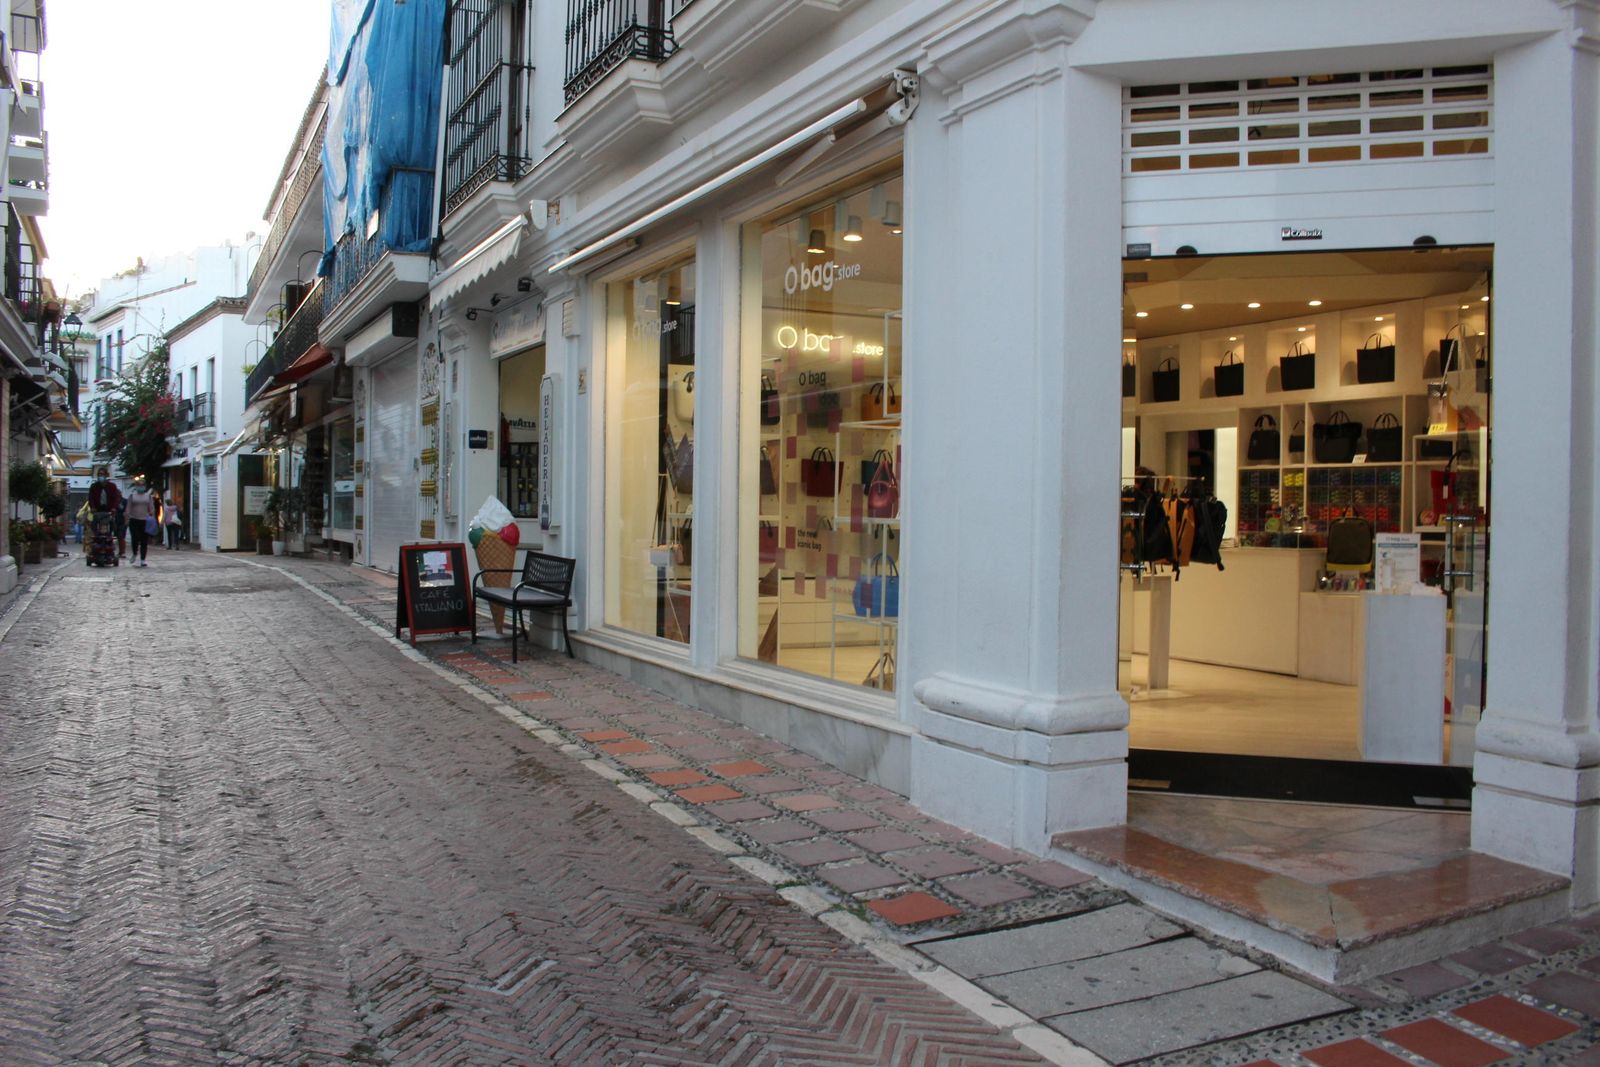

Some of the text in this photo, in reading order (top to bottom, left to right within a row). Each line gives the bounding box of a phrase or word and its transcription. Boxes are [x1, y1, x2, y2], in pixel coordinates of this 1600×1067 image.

[784, 266, 798, 295] O
[800, 260, 834, 292] bag
[777, 325, 798, 349] O
[804, 328, 836, 352] ba
[798, 369, 826, 387] O bag
[797, 528, 806, 538] the
[812, 540, 822, 552] bag
[415, 600, 464, 613] ITALIANO
